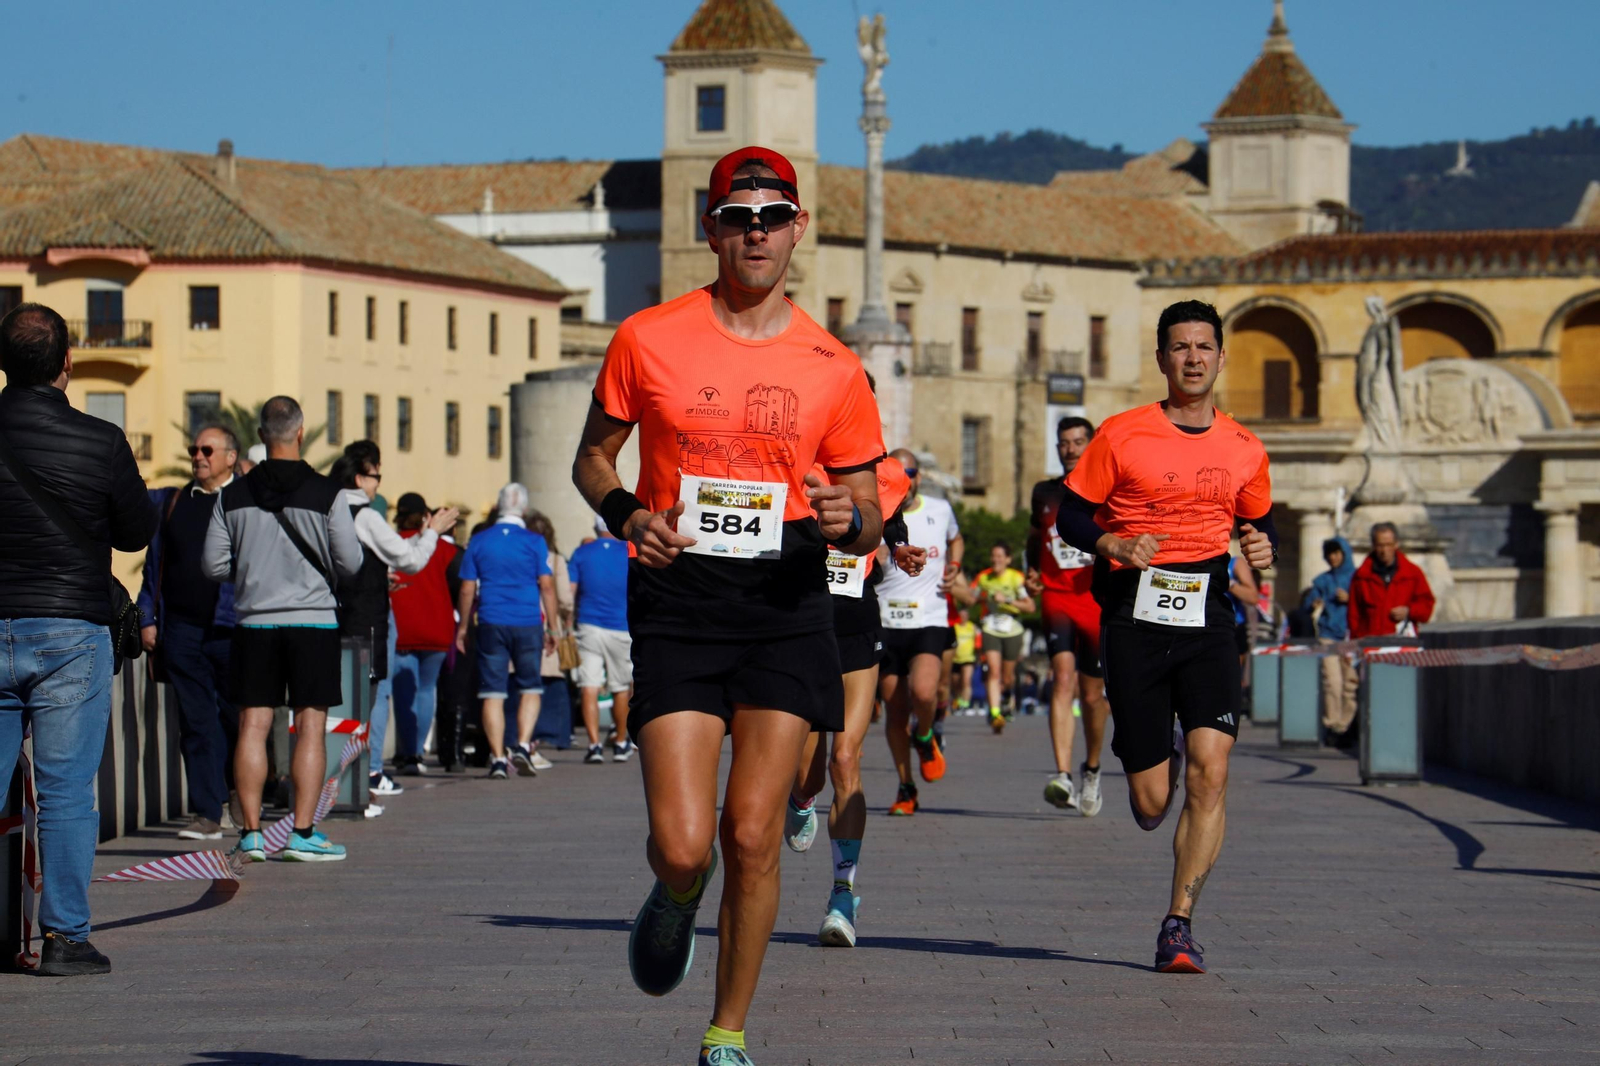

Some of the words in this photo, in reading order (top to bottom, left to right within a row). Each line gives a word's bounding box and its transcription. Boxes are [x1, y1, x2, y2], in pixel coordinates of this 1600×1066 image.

[695, 408, 730, 417] IMDECO
[721, 494, 750, 507] XXIII
[698, 511, 762, 537] 584
[1167, 582, 1187, 591] XXIII
[1156, 593, 1187, 611] 20
[889, 610, 914, 620] 195
